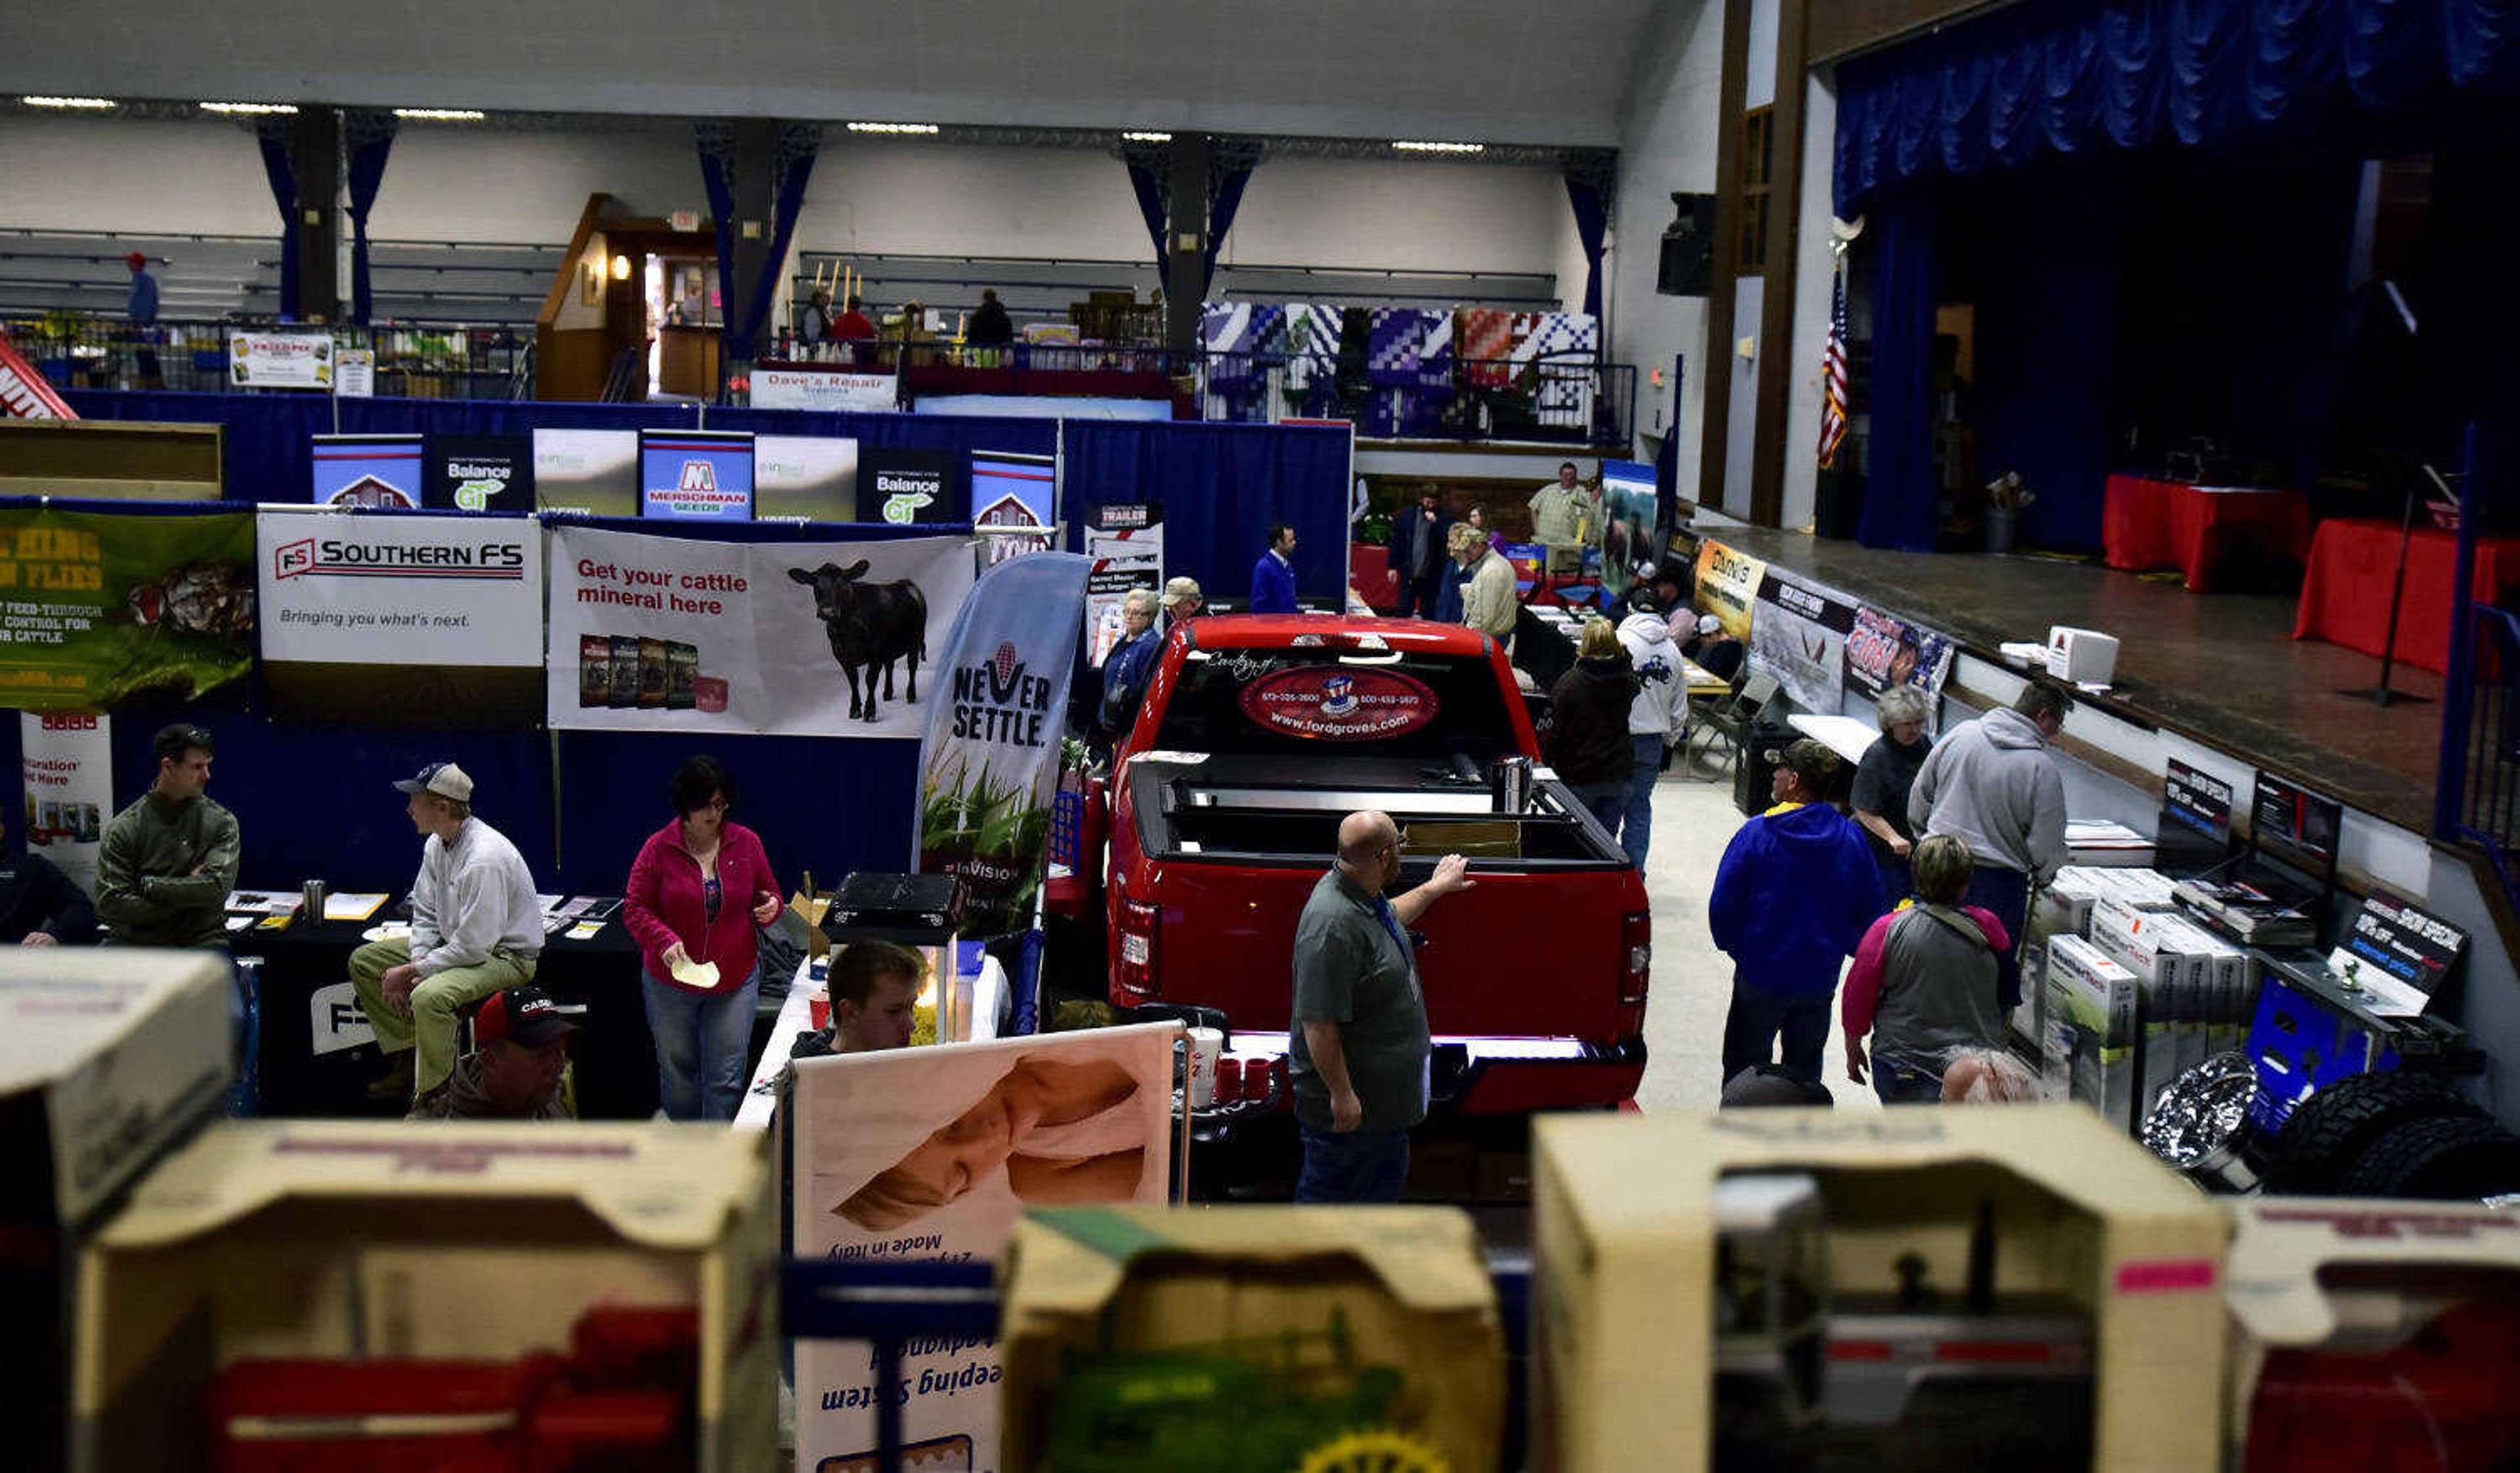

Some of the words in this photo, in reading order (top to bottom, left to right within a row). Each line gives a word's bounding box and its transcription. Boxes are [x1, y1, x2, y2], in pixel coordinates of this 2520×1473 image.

[769, 375, 822, 386] Dave's
[830, 376, 881, 388] Repair
[448, 463, 511, 478] Balance
[877, 477, 940, 492] Balance
[650, 492, 746, 503] MERSCHMAN
[673, 503, 720, 512] SEEDS
[1102, 510, 1146, 522] TRAILER
[283, 549, 307, 570] FS
[322, 541, 472, 565] SOUTHERN
[480, 544, 524, 566] FS
[578, 559, 618, 580] Get
[623, 568, 673, 587] your
[680, 573, 748, 592] cattle
[577, 585, 663, 610] mineral
[669, 593, 723, 615] here
[5, 616, 62, 630] CONTROL
[65, 618, 92, 631] FOR
[280, 610, 343, 627] Bringing
[348, 612, 375, 628] you
[380, 612, 429, 627] what's
[433, 613, 471, 627] next.
[954, 658, 1051, 713] NEVER
[952, 703, 1047, 749] SETTLE.
[1270, 711, 1410, 735] www.fordgroves.com
[827, 1241, 869, 1264] Italy
[873, 1240, 890, 1256] in
[892, 1233, 943, 1253] Made
